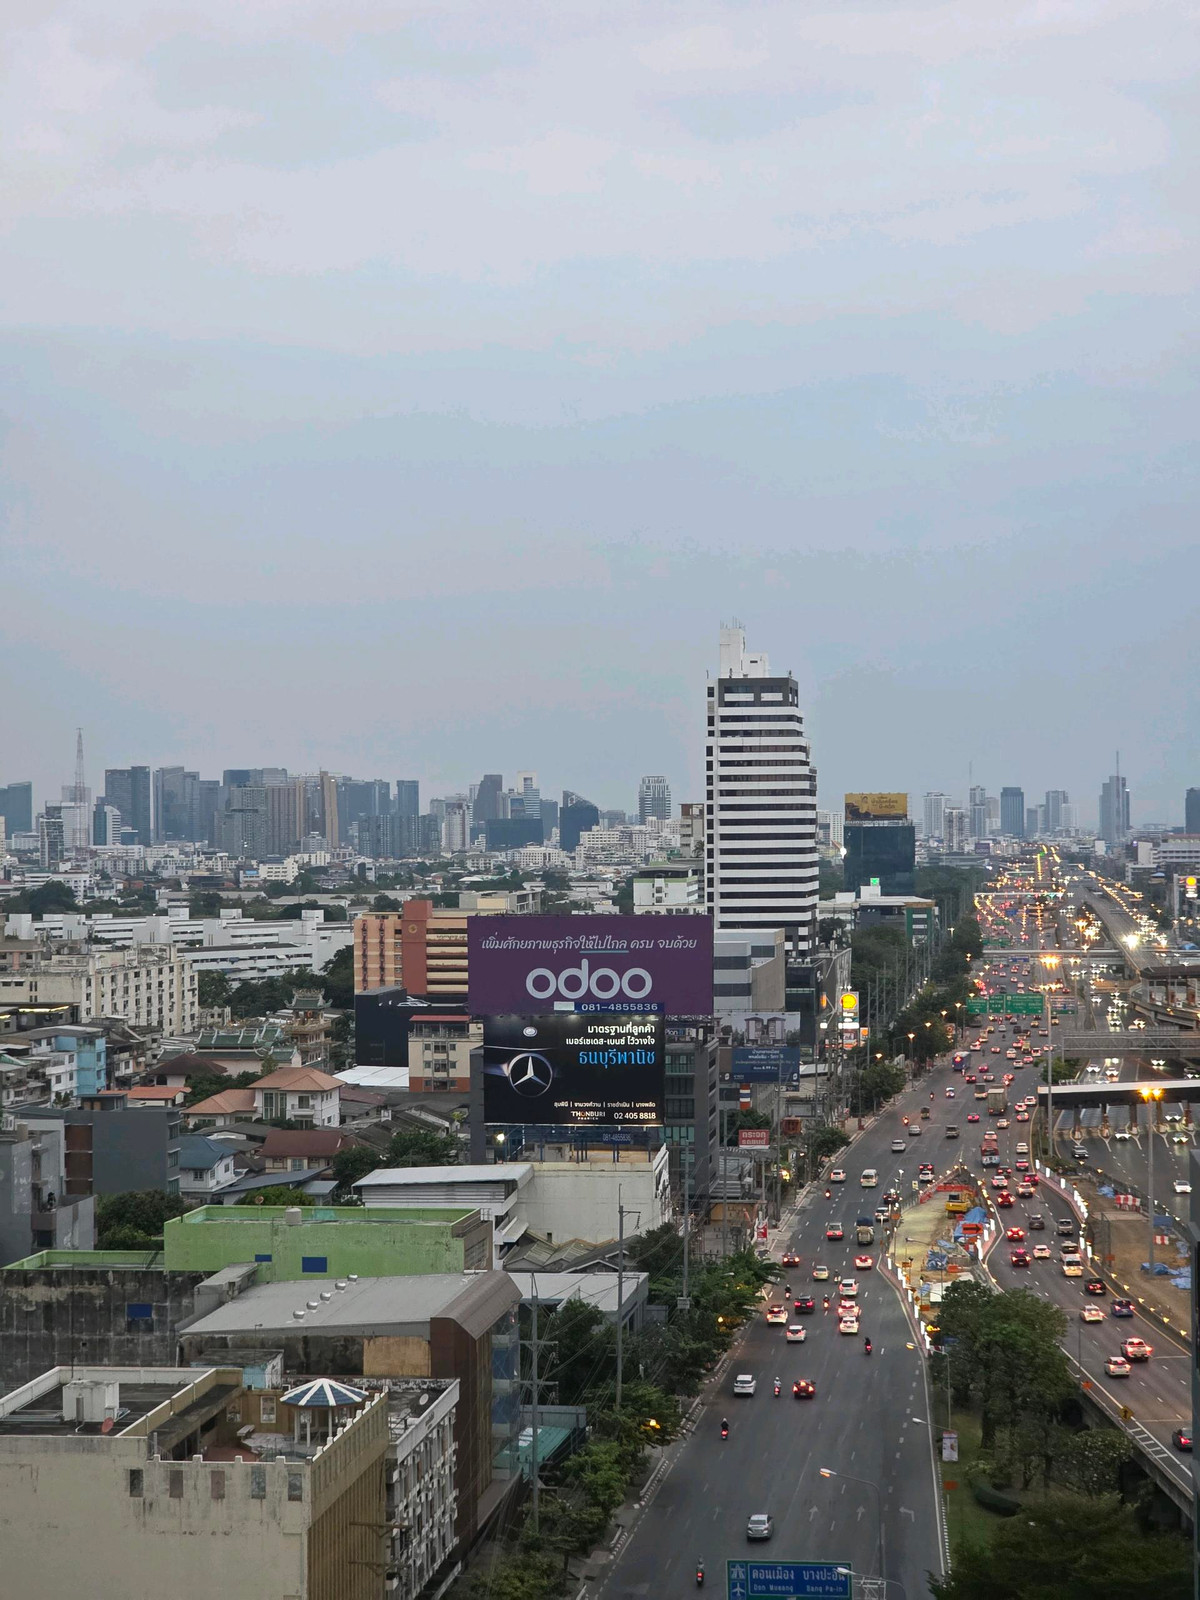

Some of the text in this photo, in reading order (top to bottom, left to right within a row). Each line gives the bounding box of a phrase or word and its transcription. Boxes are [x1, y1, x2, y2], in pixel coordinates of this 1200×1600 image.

[481, 932, 627, 954] เพิ่มศักยภาพธุรกิจให้ไปไกล
[630, 938, 654, 949] ครบ
[657, 935, 697, 949] จบด้วย
[525, 958, 653, 999] odoo
[581, 1003, 658, 1011] 081-4855836
[587, 1022, 655, 1036] มาตรฐานที่ลูกค้า
[566, 1036, 655, 1045] เมอร์เซเดส-เบนซ์ ไว้วางใจ
[579, 1048, 655, 1069] ธนบุรีพานิช
[752, 1566, 795, 1580] ดอนเมือง
